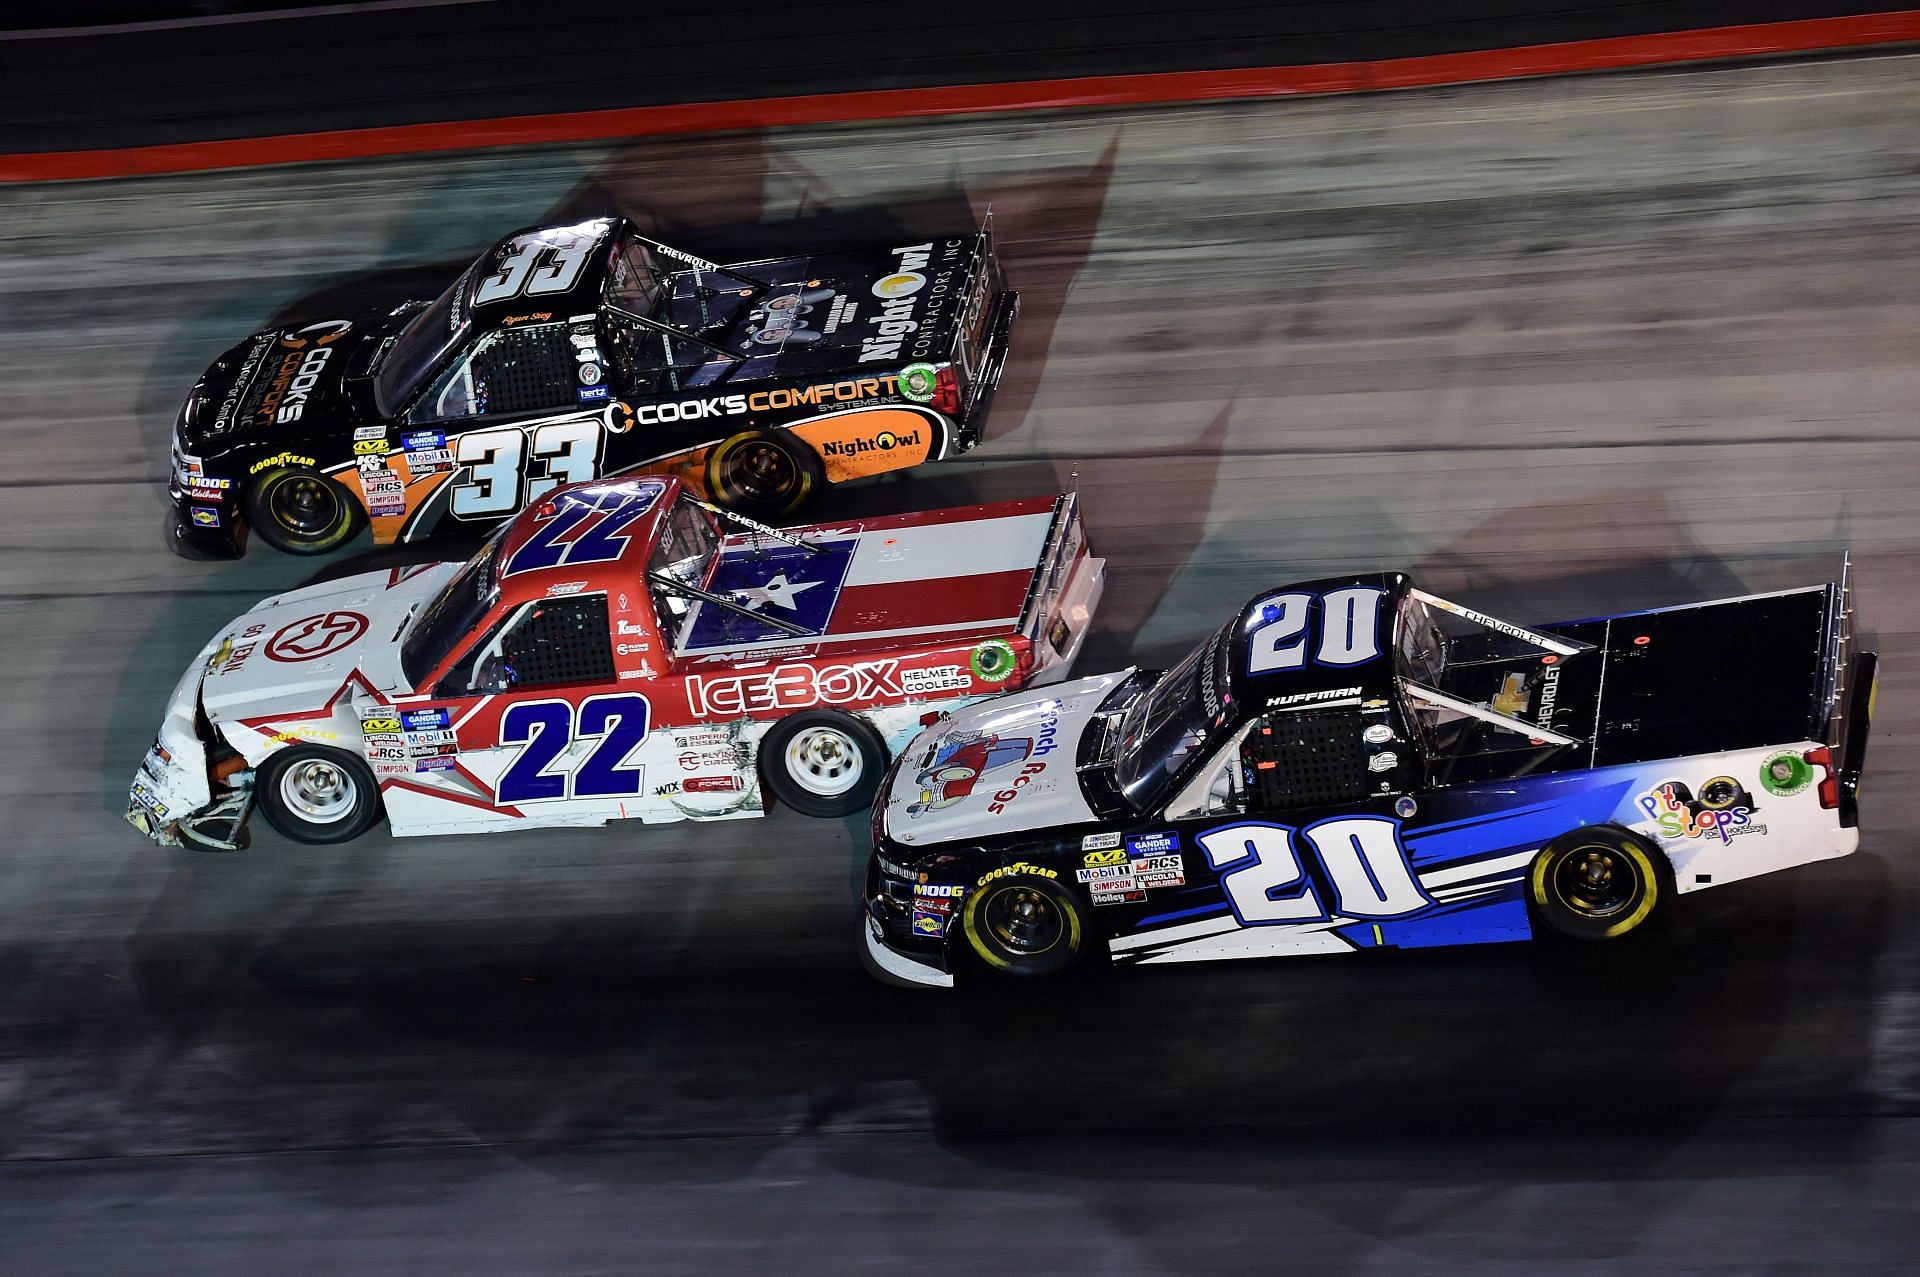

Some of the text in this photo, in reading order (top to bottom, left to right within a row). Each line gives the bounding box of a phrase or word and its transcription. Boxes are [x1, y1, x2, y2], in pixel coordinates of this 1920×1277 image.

[943, 240, 961, 261] INC
[657, 244, 720, 272] CHEVROLET
[474, 226, 605, 306] 33
[256, 352, 304, 426] COMFORT
[276, 347, 332, 424] COOK'S
[580, 387, 606, 399] hertz
[638, 375, 901, 425] COOK'S COMFORT
[903, 391, 937, 402] ETHANOL
[409, 436, 439, 445] GANDER
[250, 452, 316, 474] GOODYEAR
[408, 450, 450, 463] Mobil 1
[360, 470, 392, 479] LINCOLN
[409, 464, 436, 473] Holley
[450, 418, 607, 521] 33
[189, 477, 231, 489] MOOG
[376, 482, 402, 491] RCS
[369, 495, 401, 504] SIMPSON
[501, 481, 666, 580] 22
[727, 511, 802, 546] CHEVROLET
[242, 624, 266, 638] GO
[1247, 586, 1383, 677] 20
[1465, 610, 1548, 646] CHEVROLET
[904, 667, 956, 680] HELMET
[981, 667, 1014, 682] ETHANOL
[685, 658, 903, 717] ICEBOX
[906, 678, 969, 691] COOLERS
[1202, 652, 1220, 718] OUTDOORS
[1266, 686, 1363, 706] HUFFMAN
[1537, 665, 1560, 730] HEVROLET
[409, 714, 441, 722] GANDER
[365, 734, 397, 742] LINCOLN
[407, 731, 453, 745] Mobil 1
[380, 748, 405, 759] RCS
[410, 746, 438, 756] Holley
[494, 692, 651, 807] 22
[1761, 750, 1805, 768] AMERICAN
[376, 764, 409, 773] SIMPSON
[655, 781, 680, 796] WIX
[1771, 781, 1810, 797] ETHANOL
[135, 785, 167, 815] MOOG
[1640, 784, 1681, 819] Pit
[1656, 807, 1751, 845] Stops
[1134, 839, 1171, 849] GANDER
[1149, 856, 1180, 869] RCS
[977, 862, 1058, 887] GOODYEAR
[1079, 867, 1115, 880] Mobil
[1118, 866, 1130, 876] 1
[1138, 872, 1176, 882] LINCOLN
[1195, 814, 1438, 927] 20
[1093, 879, 1131, 890] SIMPSON
[1147, 878, 1181, 887] WELDERS
[913, 884, 965, 897] MOOG
[1094, 893, 1125, 903] Holley
[914, 920, 942, 929] SUNOCO
